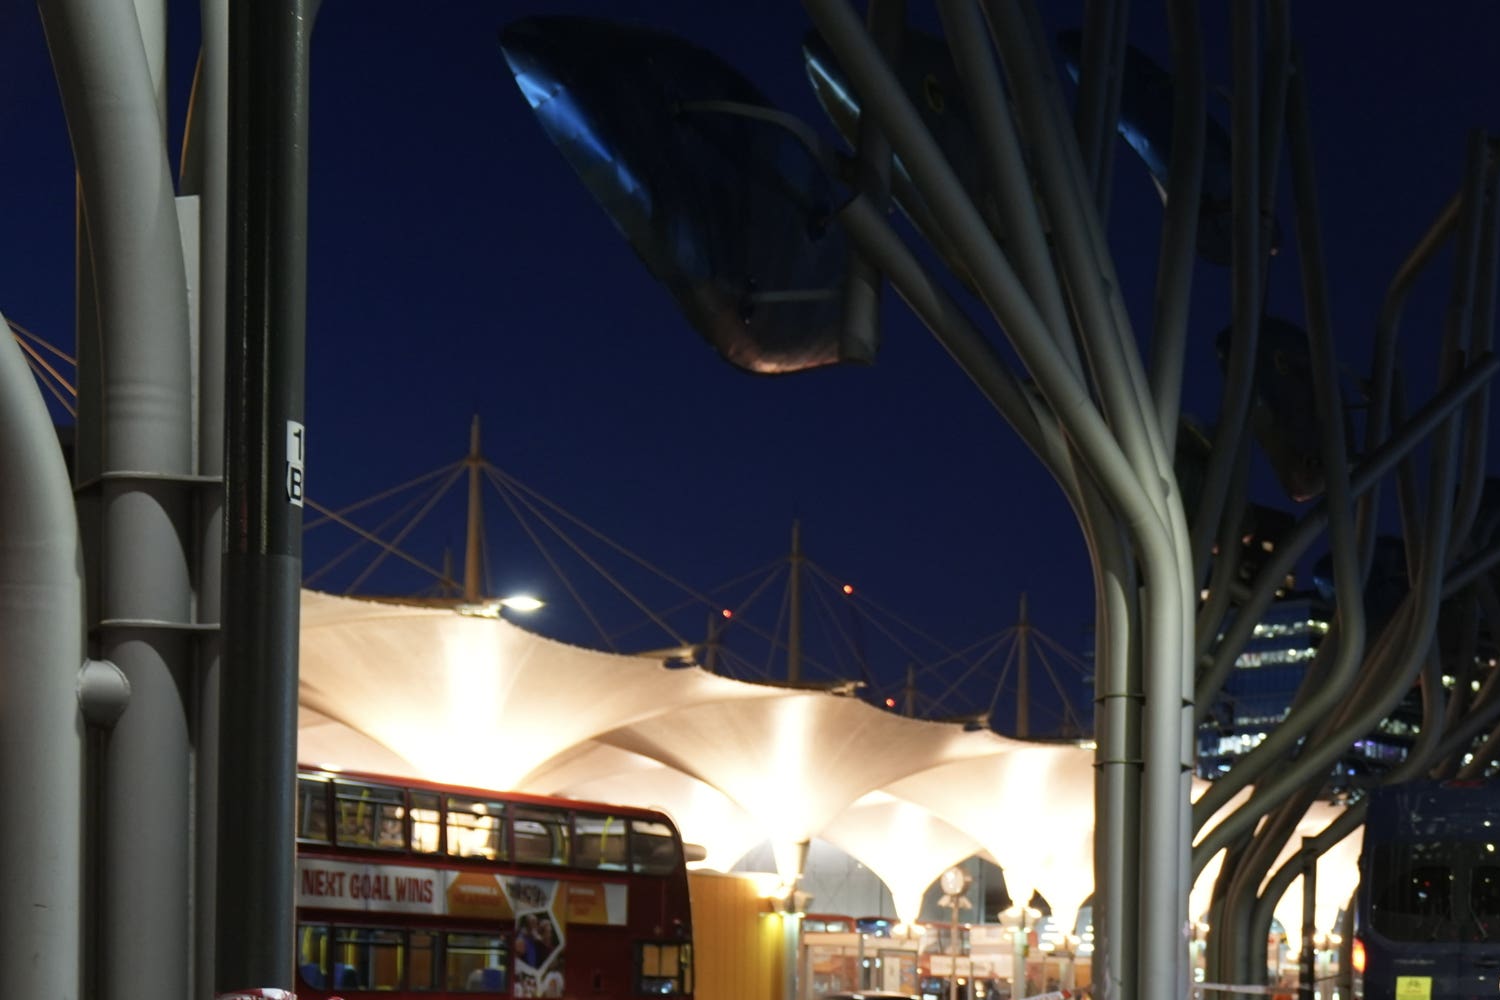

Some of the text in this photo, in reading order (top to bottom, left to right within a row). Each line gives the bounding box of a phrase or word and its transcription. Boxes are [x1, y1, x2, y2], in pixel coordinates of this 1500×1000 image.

[302, 869, 346, 899] NEXT
[349, 871, 392, 903] GOAL
[394, 877, 433, 904] WINS
